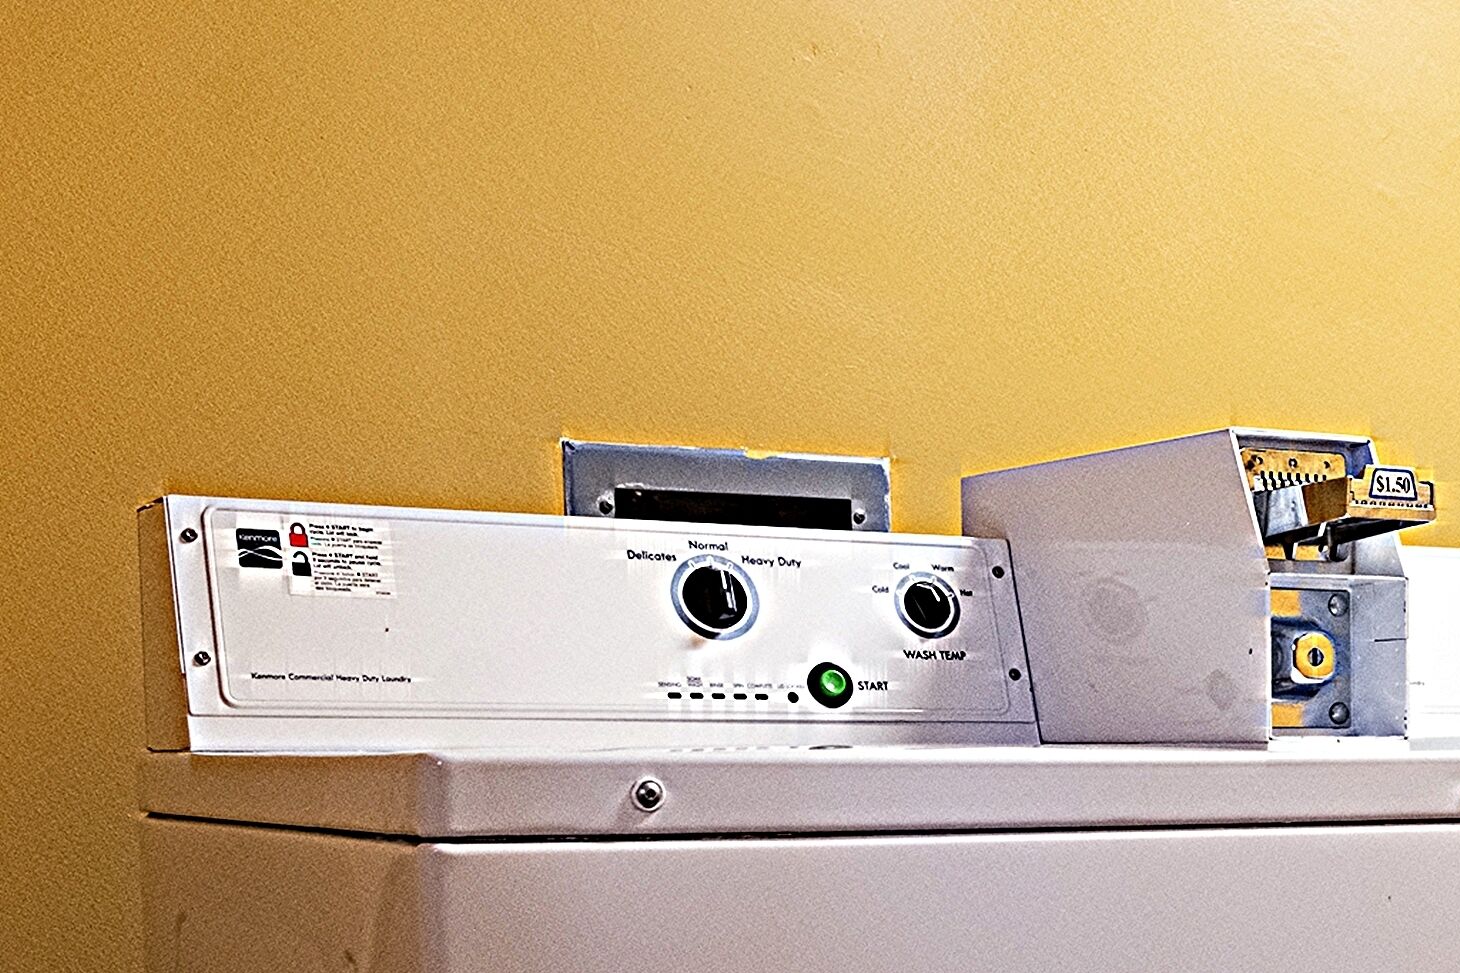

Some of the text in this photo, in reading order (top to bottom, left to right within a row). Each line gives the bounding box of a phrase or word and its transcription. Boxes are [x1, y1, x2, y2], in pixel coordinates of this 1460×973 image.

[1376, 475, 1411, 493] $1.50
[238, 533, 278, 543] Kenmore
[688, 540, 729, 551] Normal
[627, 549, 677, 562] Delicates
[741, 555, 802, 568] Heavy Duty
[931, 564, 954, 572] Warm
[871, 585, 889, 594] Cold
[903, 649, 967, 661] WASH TEMP
[251, 672, 411, 683] Kenmore Commercial Heavy Duty Laundry
[857, 681, 889, 691] START
